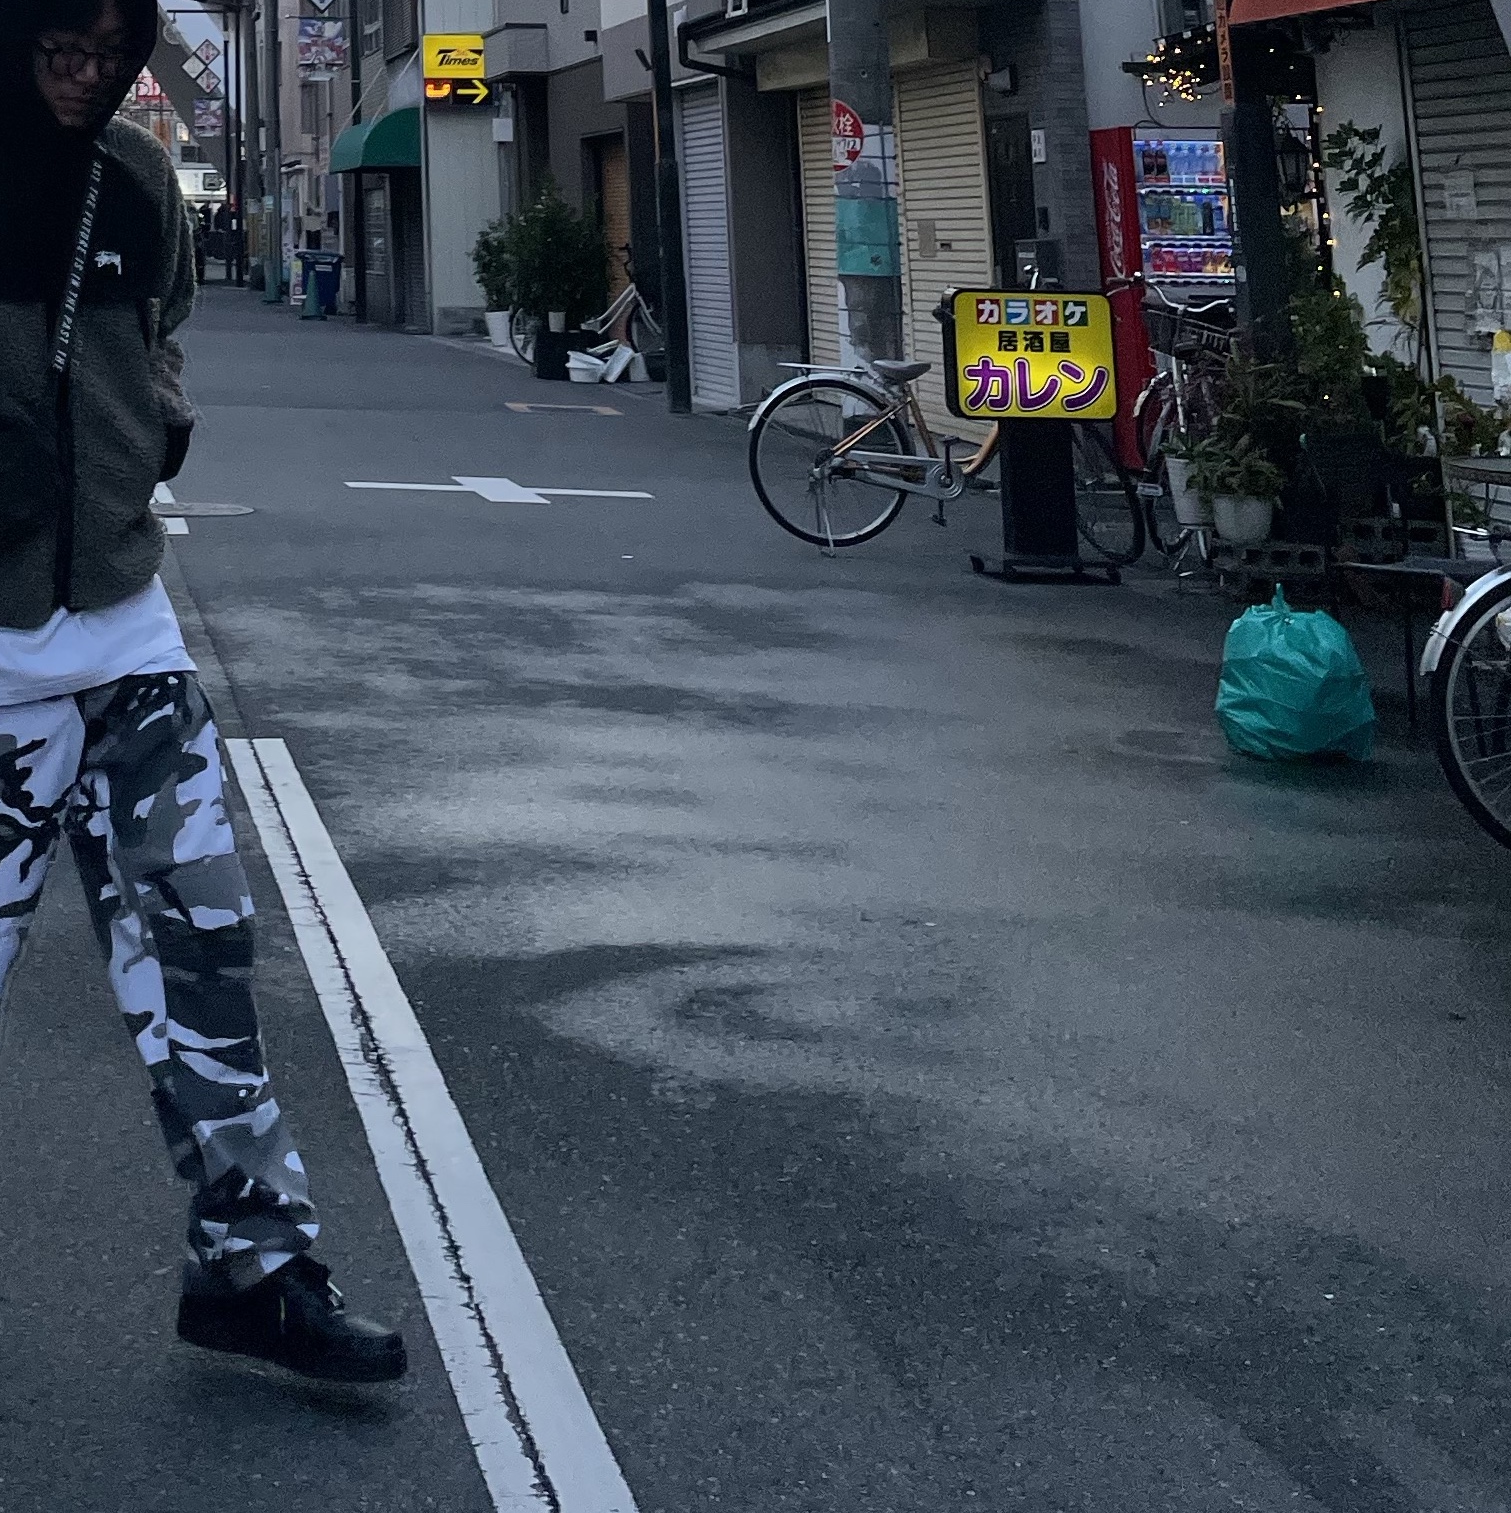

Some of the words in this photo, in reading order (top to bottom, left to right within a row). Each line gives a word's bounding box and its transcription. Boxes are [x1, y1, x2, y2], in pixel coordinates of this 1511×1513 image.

[436, 48, 484, 67] Times
[977, 299, 1087, 325] カラオケ
[997, 330, 1071, 353] 居酒屋
[963, 355, 1109, 411] カレン
